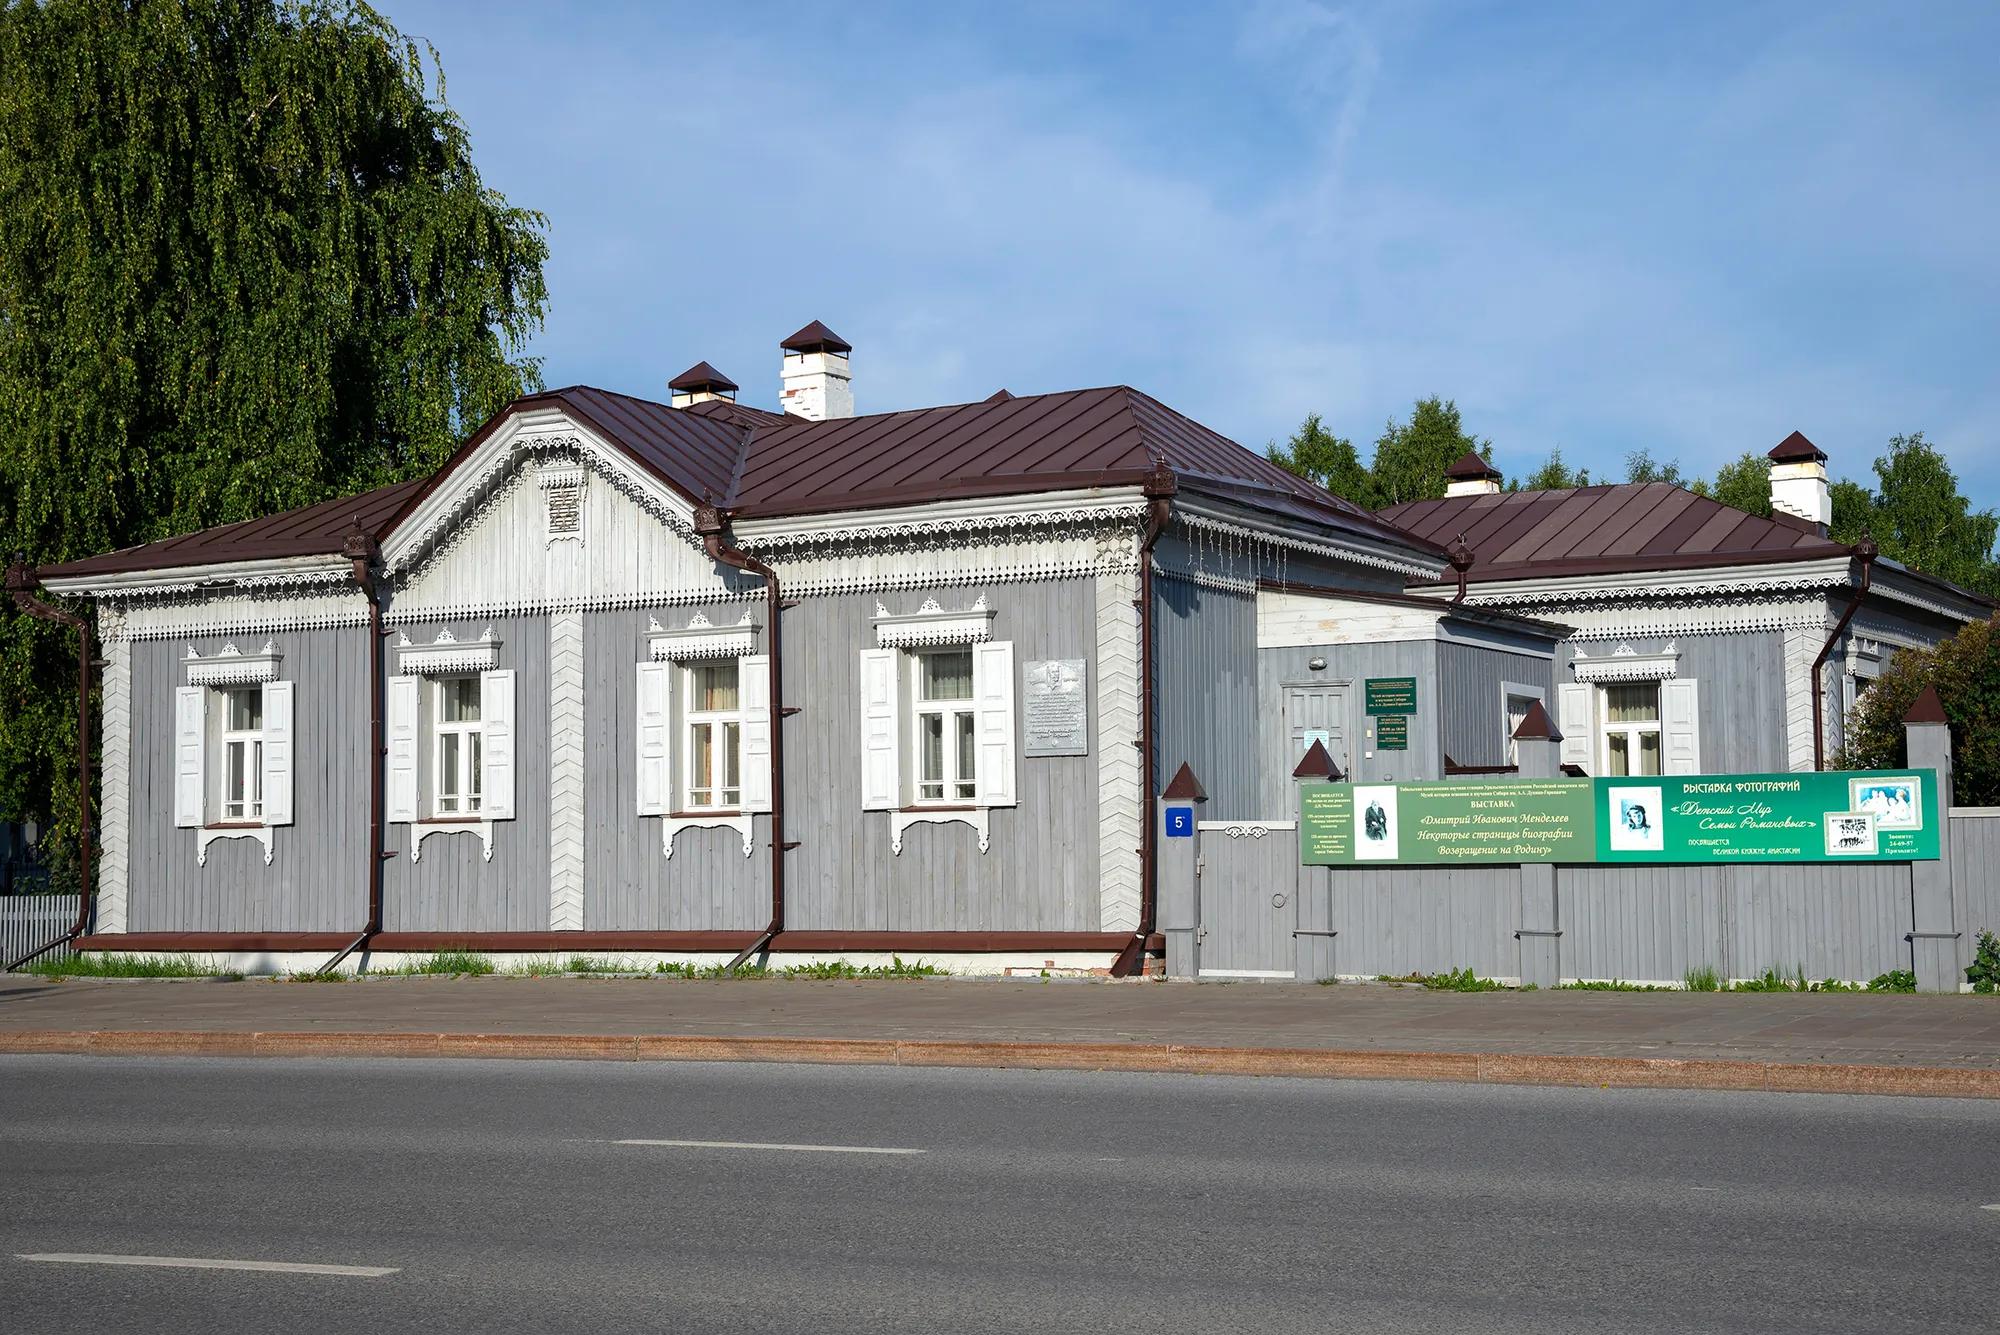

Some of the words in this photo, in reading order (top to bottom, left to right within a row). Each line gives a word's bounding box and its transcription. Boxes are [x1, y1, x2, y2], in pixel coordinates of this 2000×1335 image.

[1683, 783, 1732, 794] ВЫСТАВКА
[1735, 780, 1800, 793] ФОТОГРАФИЙ
[1471, 800, 1515, 809] ВЫСТАВКА
[1670, 801, 1734, 816] «Детский
[1737, 801, 1773, 818] Мир
[1175, 816, 1183, 829] 5
[1421, 815, 1471, 828] «Дмитрий
[1472, 813, 1518, 824] Иванович
[1519, 811, 1569, 823] Менделеев
[1699, 817, 1737, 830] Семьи
[1740, 816, 1817, 829] Романовых»
[1417, 831, 1470, 843] Некоторые
[1472, 831, 1520, 842] страницы
[1522, 828, 1573, 842] биографии
[1688, 838, 1730, 846] ПОСВЯЩАЕТСЯ
[1438, 846, 1498, 858] Возвращение
[1513, 844, 1553, 857] Родину»
